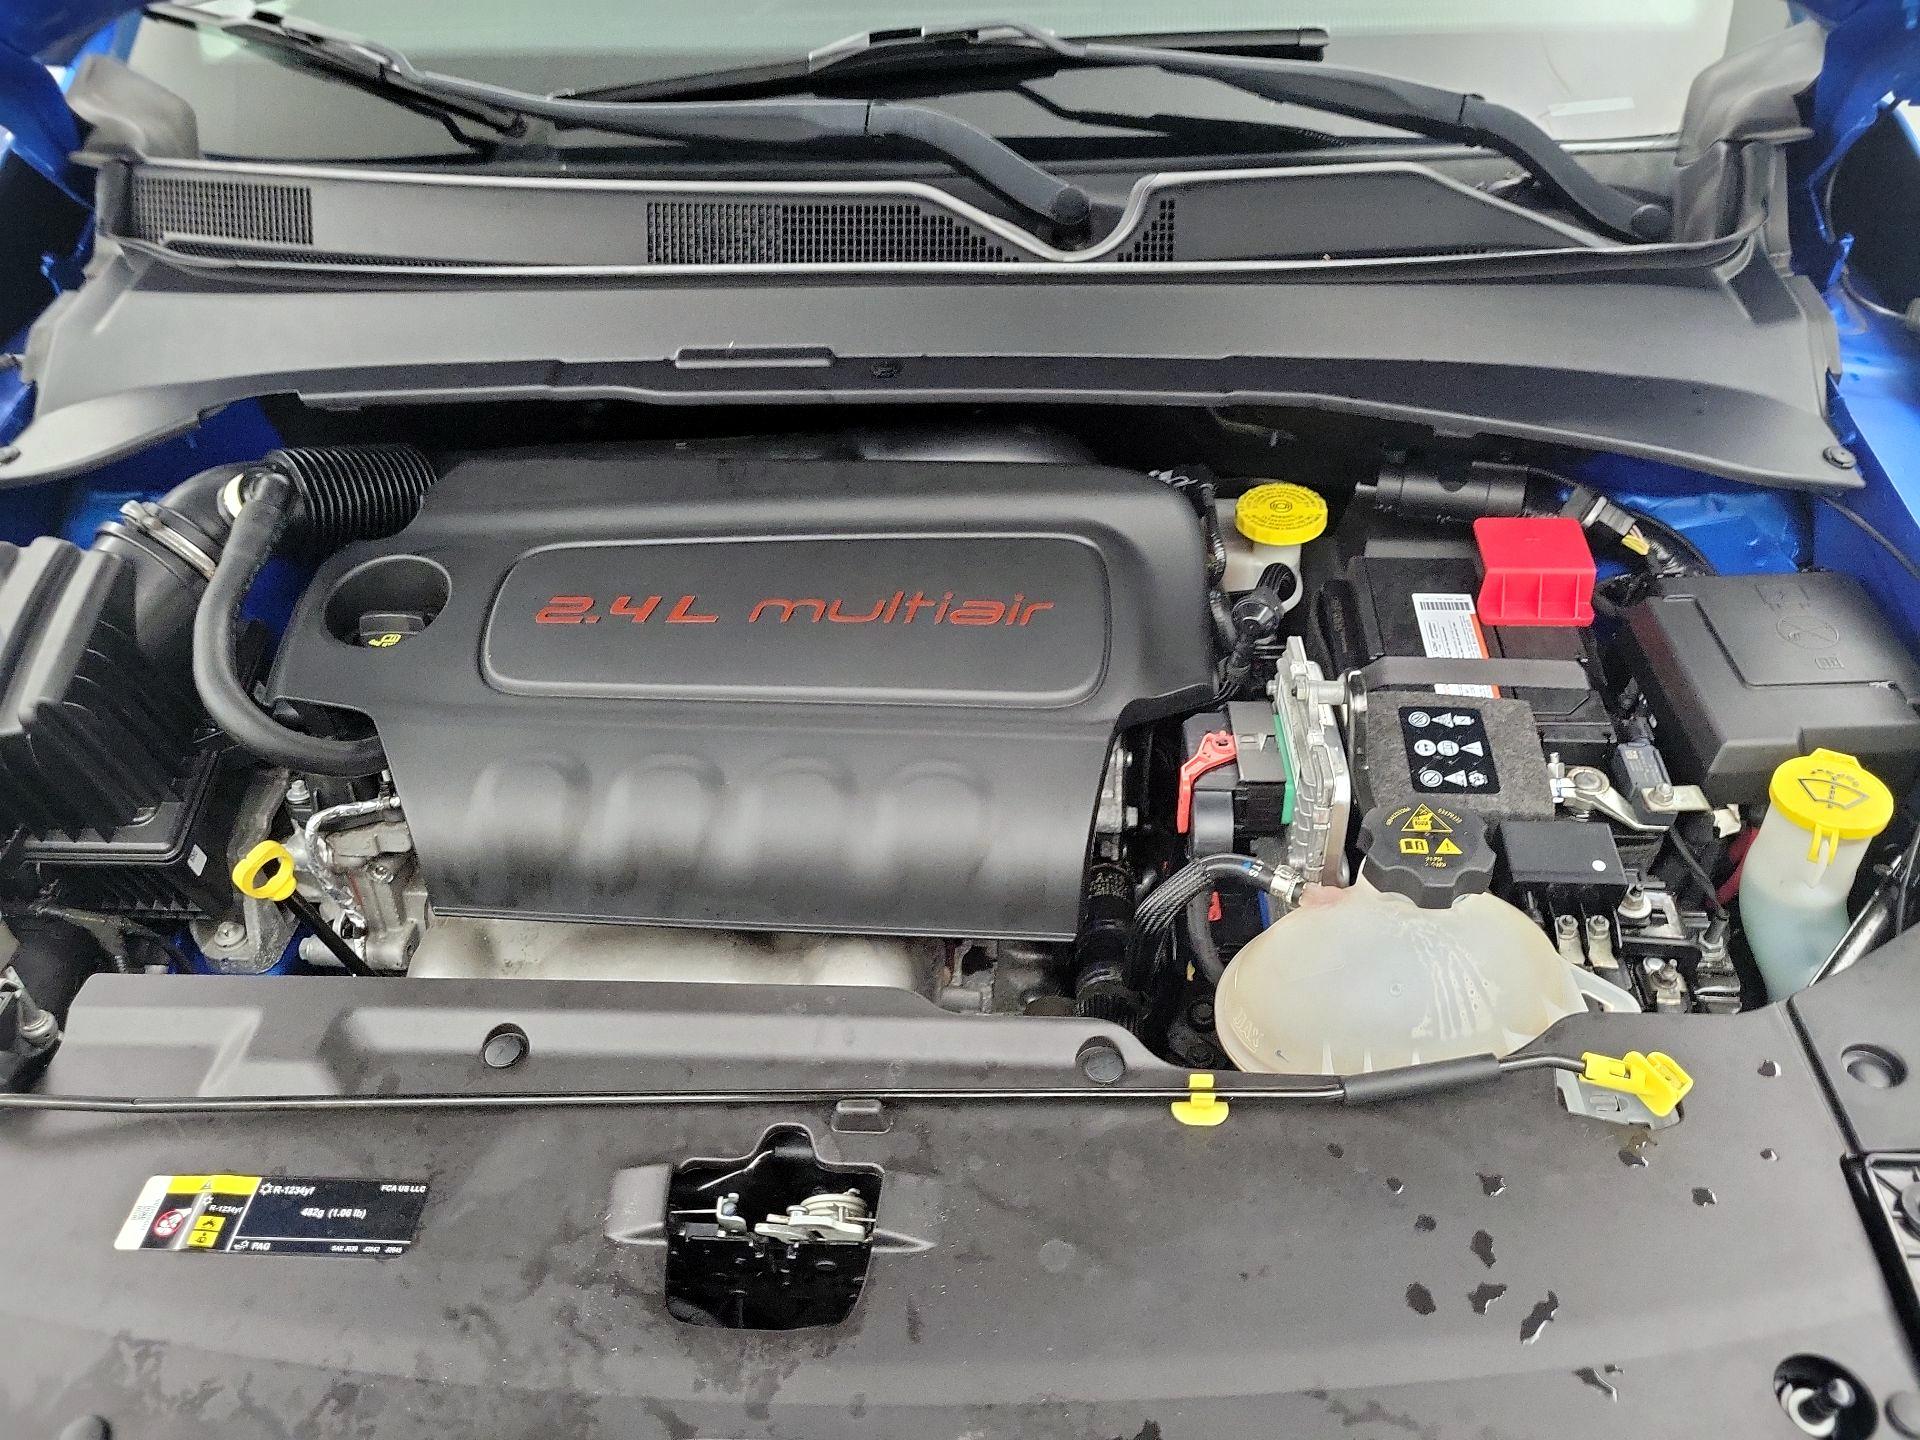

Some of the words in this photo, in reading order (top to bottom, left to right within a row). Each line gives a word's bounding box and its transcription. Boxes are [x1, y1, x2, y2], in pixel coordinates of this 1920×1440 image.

[748, 591, 1054, 625] multiair
[273, 1186, 315, 1197] R-1234yf
[209, 1204, 243, 1215] R-1234yf
[251, 1242, 271, 1250] PAG
